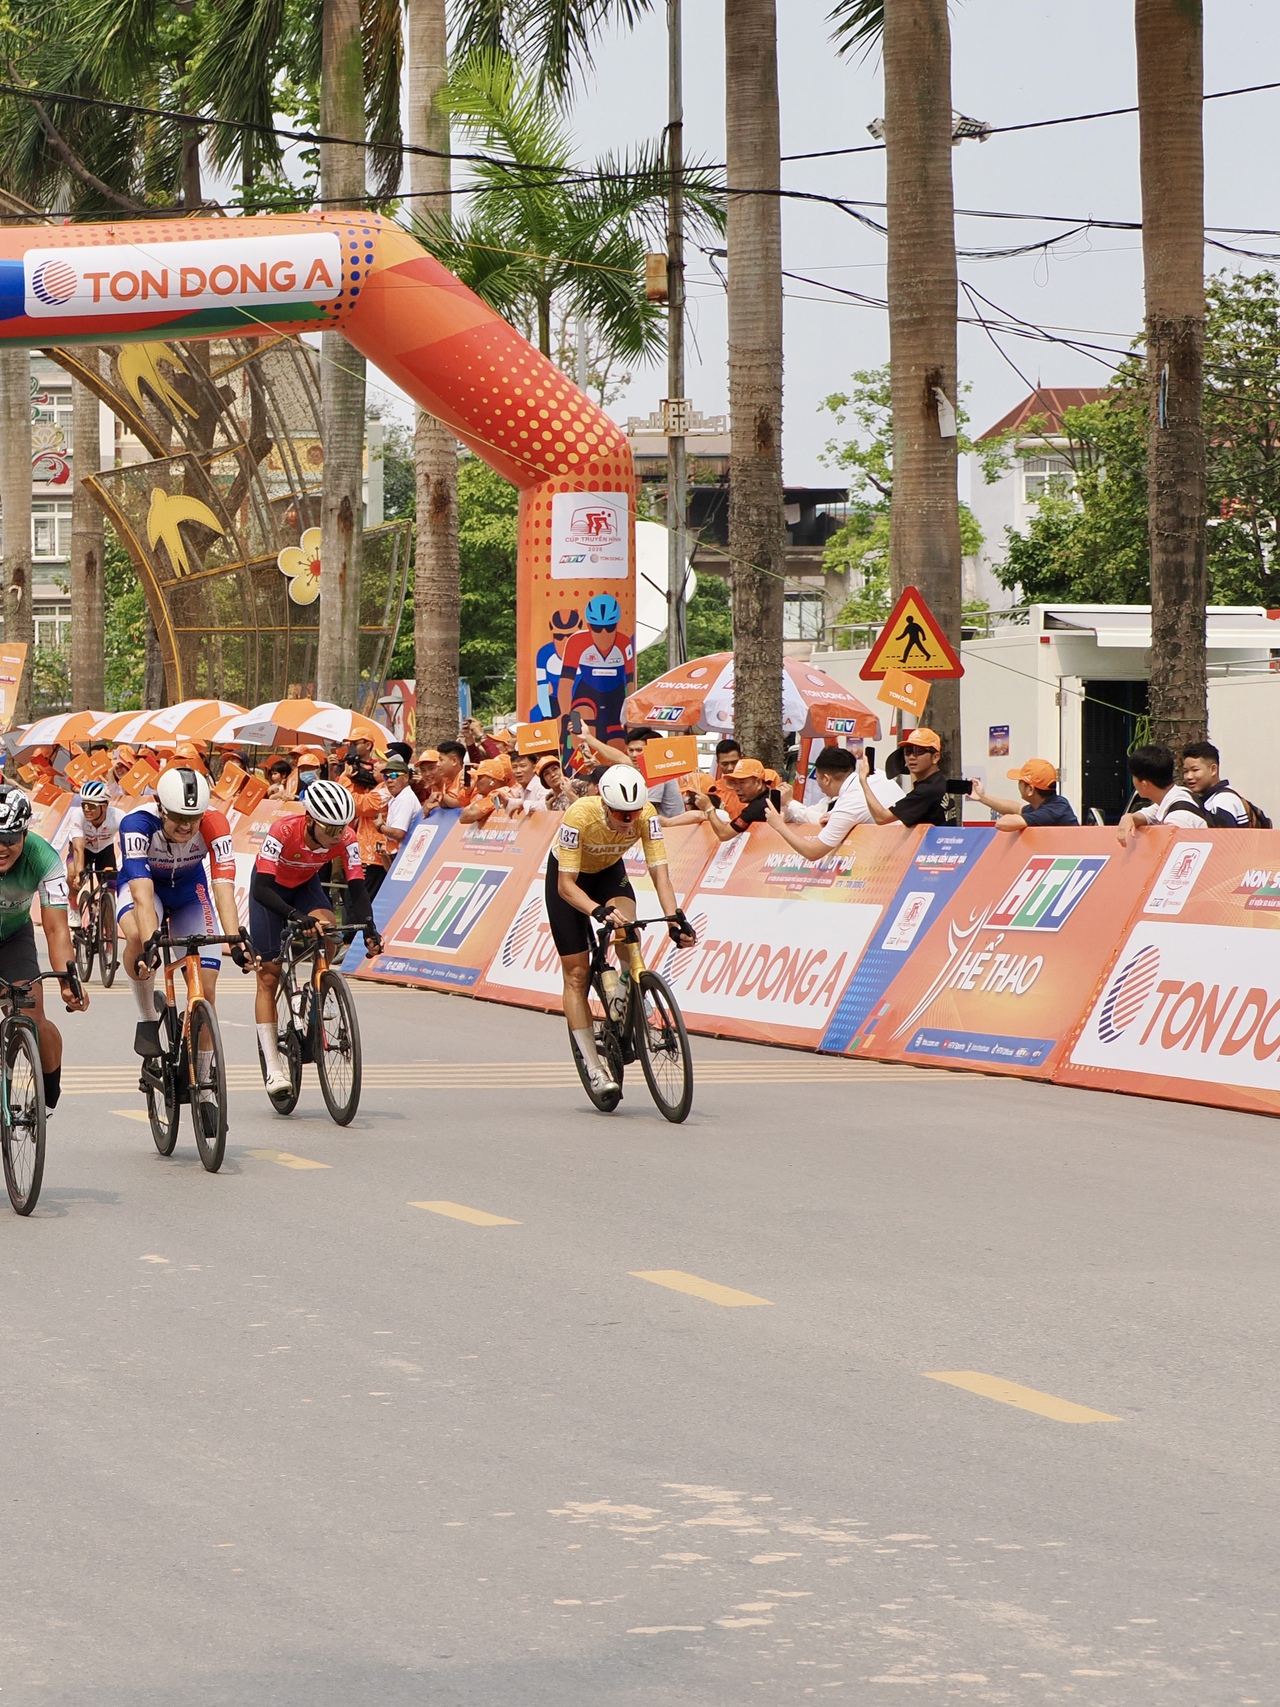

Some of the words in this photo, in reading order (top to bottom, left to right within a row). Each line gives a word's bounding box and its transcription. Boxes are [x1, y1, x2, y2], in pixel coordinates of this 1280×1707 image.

[82, 268, 170, 303] TON
[179, 261, 297, 298] DONG
[303, 257, 335, 290] A
[580, 535, 608, 543] TRUYỀN
[560, 554, 585, 563] HTV
[655, 681, 675, 690] TON
[674, 682, 703, 690] DONG
[699, 682, 710, 690] A
[801, 689, 821, 698] TON
[821, 691, 845, 701] DONG
[845, 692, 856, 702] A
[646, 707, 682, 721] HTV
[826, 718, 856, 732] HTV
[560, 827, 577, 844] 137
[127, 837, 148, 853] 107
[213, 839, 233, 857] 107
[263, 839, 277, 855] 85
[1240, 869, 1273, 889] NON
[57, 882, 67, 898] 1
[995, 868, 1098, 917] HTV
[402, 878, 499, 937] HTV
[686, 938, 755, 997] TON
[736, 943, 828, 1006] DONG
[817, 950, 849, 1008] A
[980, 952, 1044, 995] THAO
[1138, 979, 1239, 1054] TON
[1218, 987, 1280, 1063] DO
